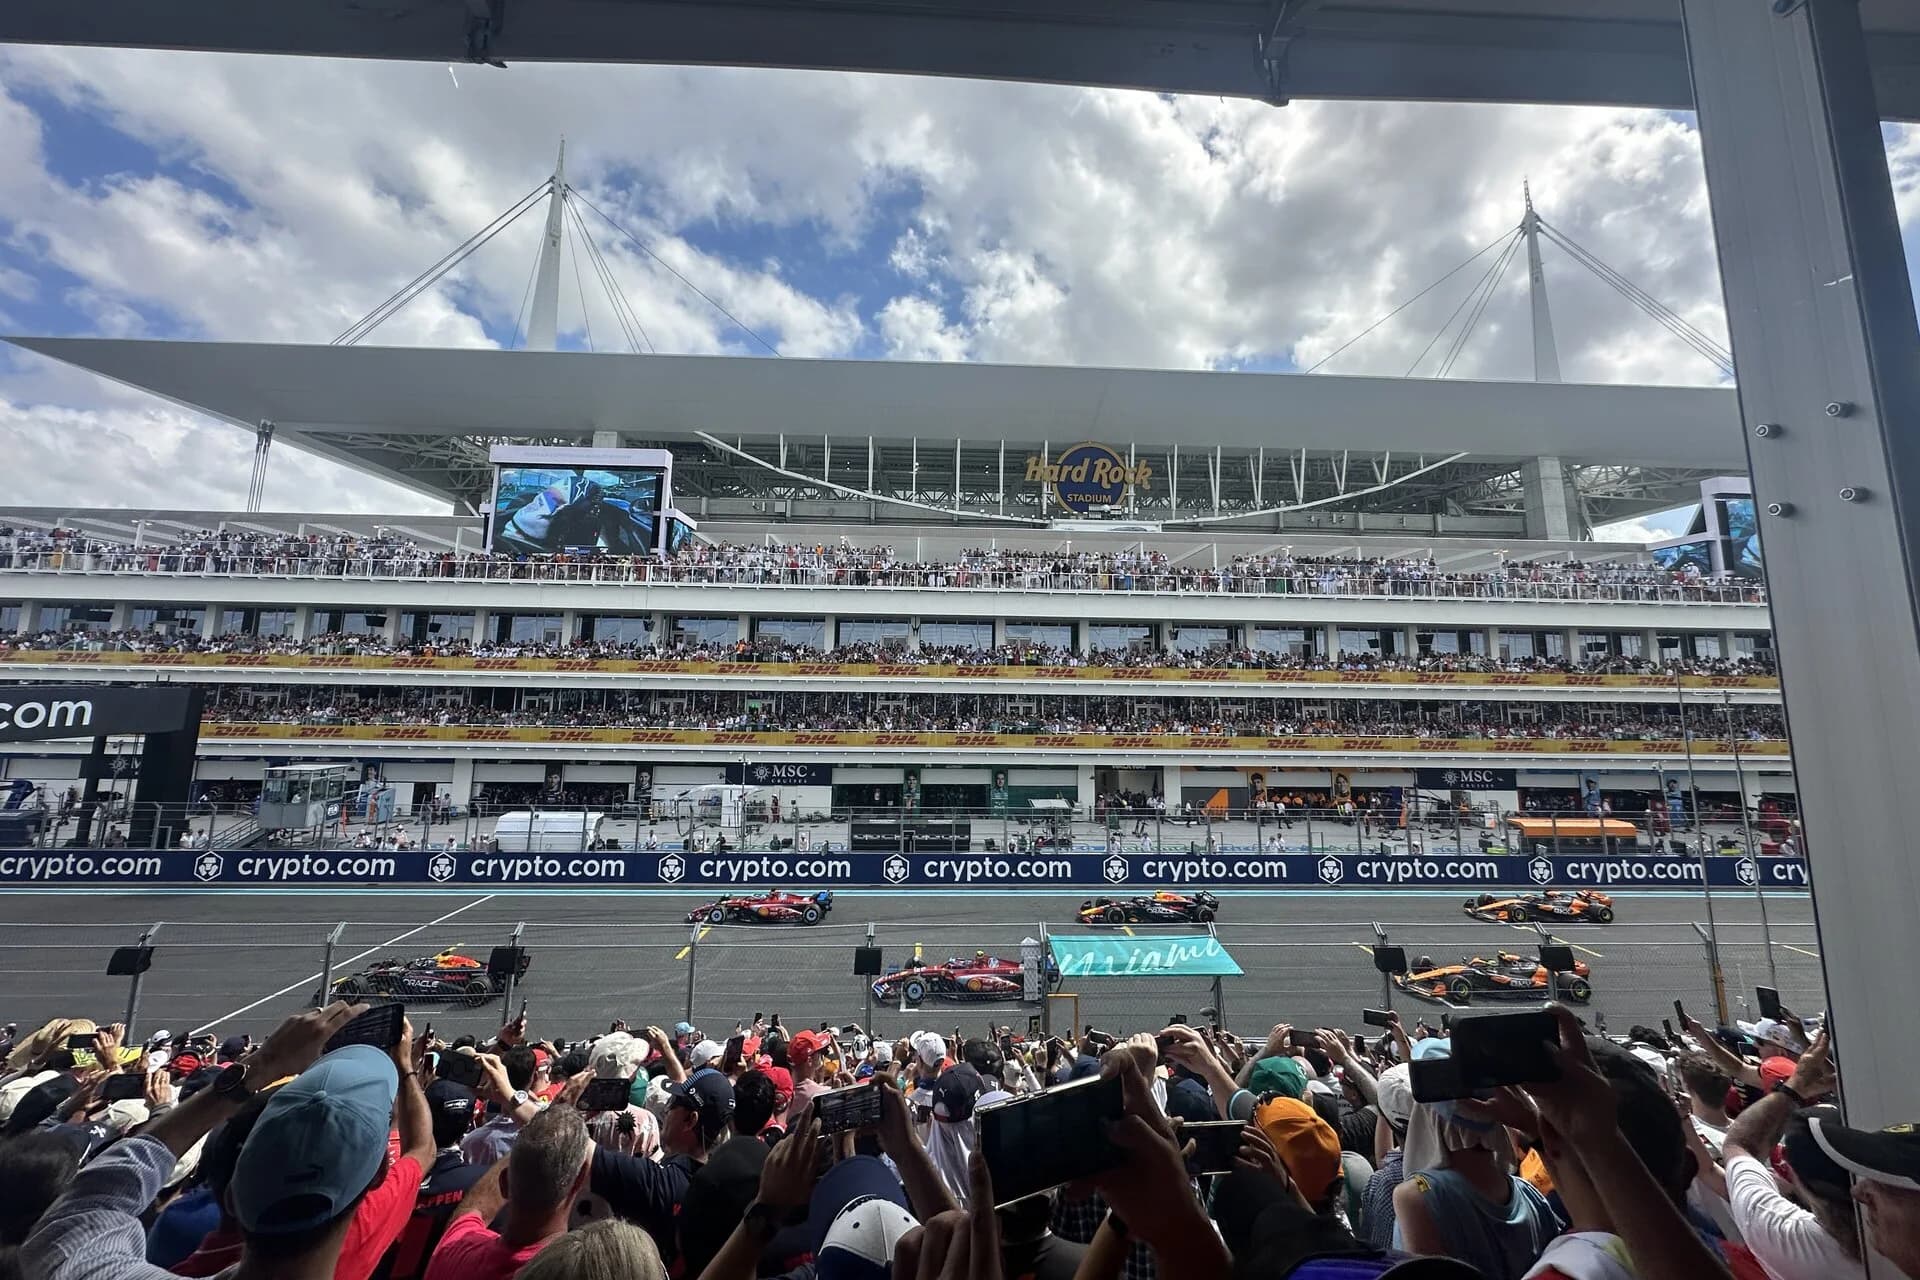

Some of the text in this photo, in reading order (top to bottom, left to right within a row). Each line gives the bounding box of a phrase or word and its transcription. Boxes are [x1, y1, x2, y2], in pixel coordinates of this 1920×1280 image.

[1024, 456, 1152, 489] Hard Rock
[1066, 493, 1111, 504] STADIUM
[57, 653, 100, 662] DHL
[142, 654, 186, 664] DHL
[225, 656, 272, 666] DHL
[308, 657, 354, 667] DHL
[392, 658, 435, 668] DHL
[474, 660, 518, 669] DHL
[556, 661, 600, 671] DHL
[637, 662, 681, 672] DHL
[718, 664, 761, 674] DHL
[800, 665, 842, 675] DHL
[878, 666, 921, 675] DHL
[956, 667, 999, 676] DHL
[1034, 668, 1077, 677] DHL
[1112, 669, 1154, 679] DHL
[1190, 670, 1231, 680] DHL
[1266, 671, 1306, 681] DHL
[1341, 673, 1382, 682] DHL
[1416, 674, 1455, 683] DHL
[1490, 675, 1531, 684] DHL
[1565, 676, 1604, 685] DHL
[1639, 677, 1678, 686] DHL
[1710, 677, 1749, 687] DHL
[214, 727, 259, 736] DHL
[299, 728, 344, 737] DHL
[383, 729, 428, 739] DHL
[466, 730, 511, 740] DHL
[550, 731, 594, 741] DHL
[632, 732, 676, 742] DHL
[713, 734, 758, 743] DHL
[794, 734, 838, 744] DHL
[875, 735, 919, 745] DHL
[956, 736, 998, 746] DHL
[1034, 737, 1076, 746] DHL
[1112, 738, 1154, 747] DHL
[1190, 738, 1232, 748] DHL
[1267, 739, 1309, 748] DHL
[1344, 740, 1385, 749] DHL
[1419, 741, 1459, 750] DHL
[1494, 742, 1534, 751] DHL
[1568, 743, 1609, 752] DHL
[1643, 743, 1683, 752] DHL
[772, 765, 808, 778] MSC
[1460, 770, 1494, 783] MSC
[0, 854, 161, 878] crypto.com
[239, 855, 395, 879] crypto.com
[471, 856, 625, 880] crypto.com
[700, 857, 851, 881] crypto.com
[924, 857, 1071, 881] crypto.com
[1143, 858, 1286, 882] crypto.com
[1357, 858, 1498, 882] crypto.com
[1567, 860, 1703, 883] crypto.com
[402, 978, 439, 988] ORACLE
